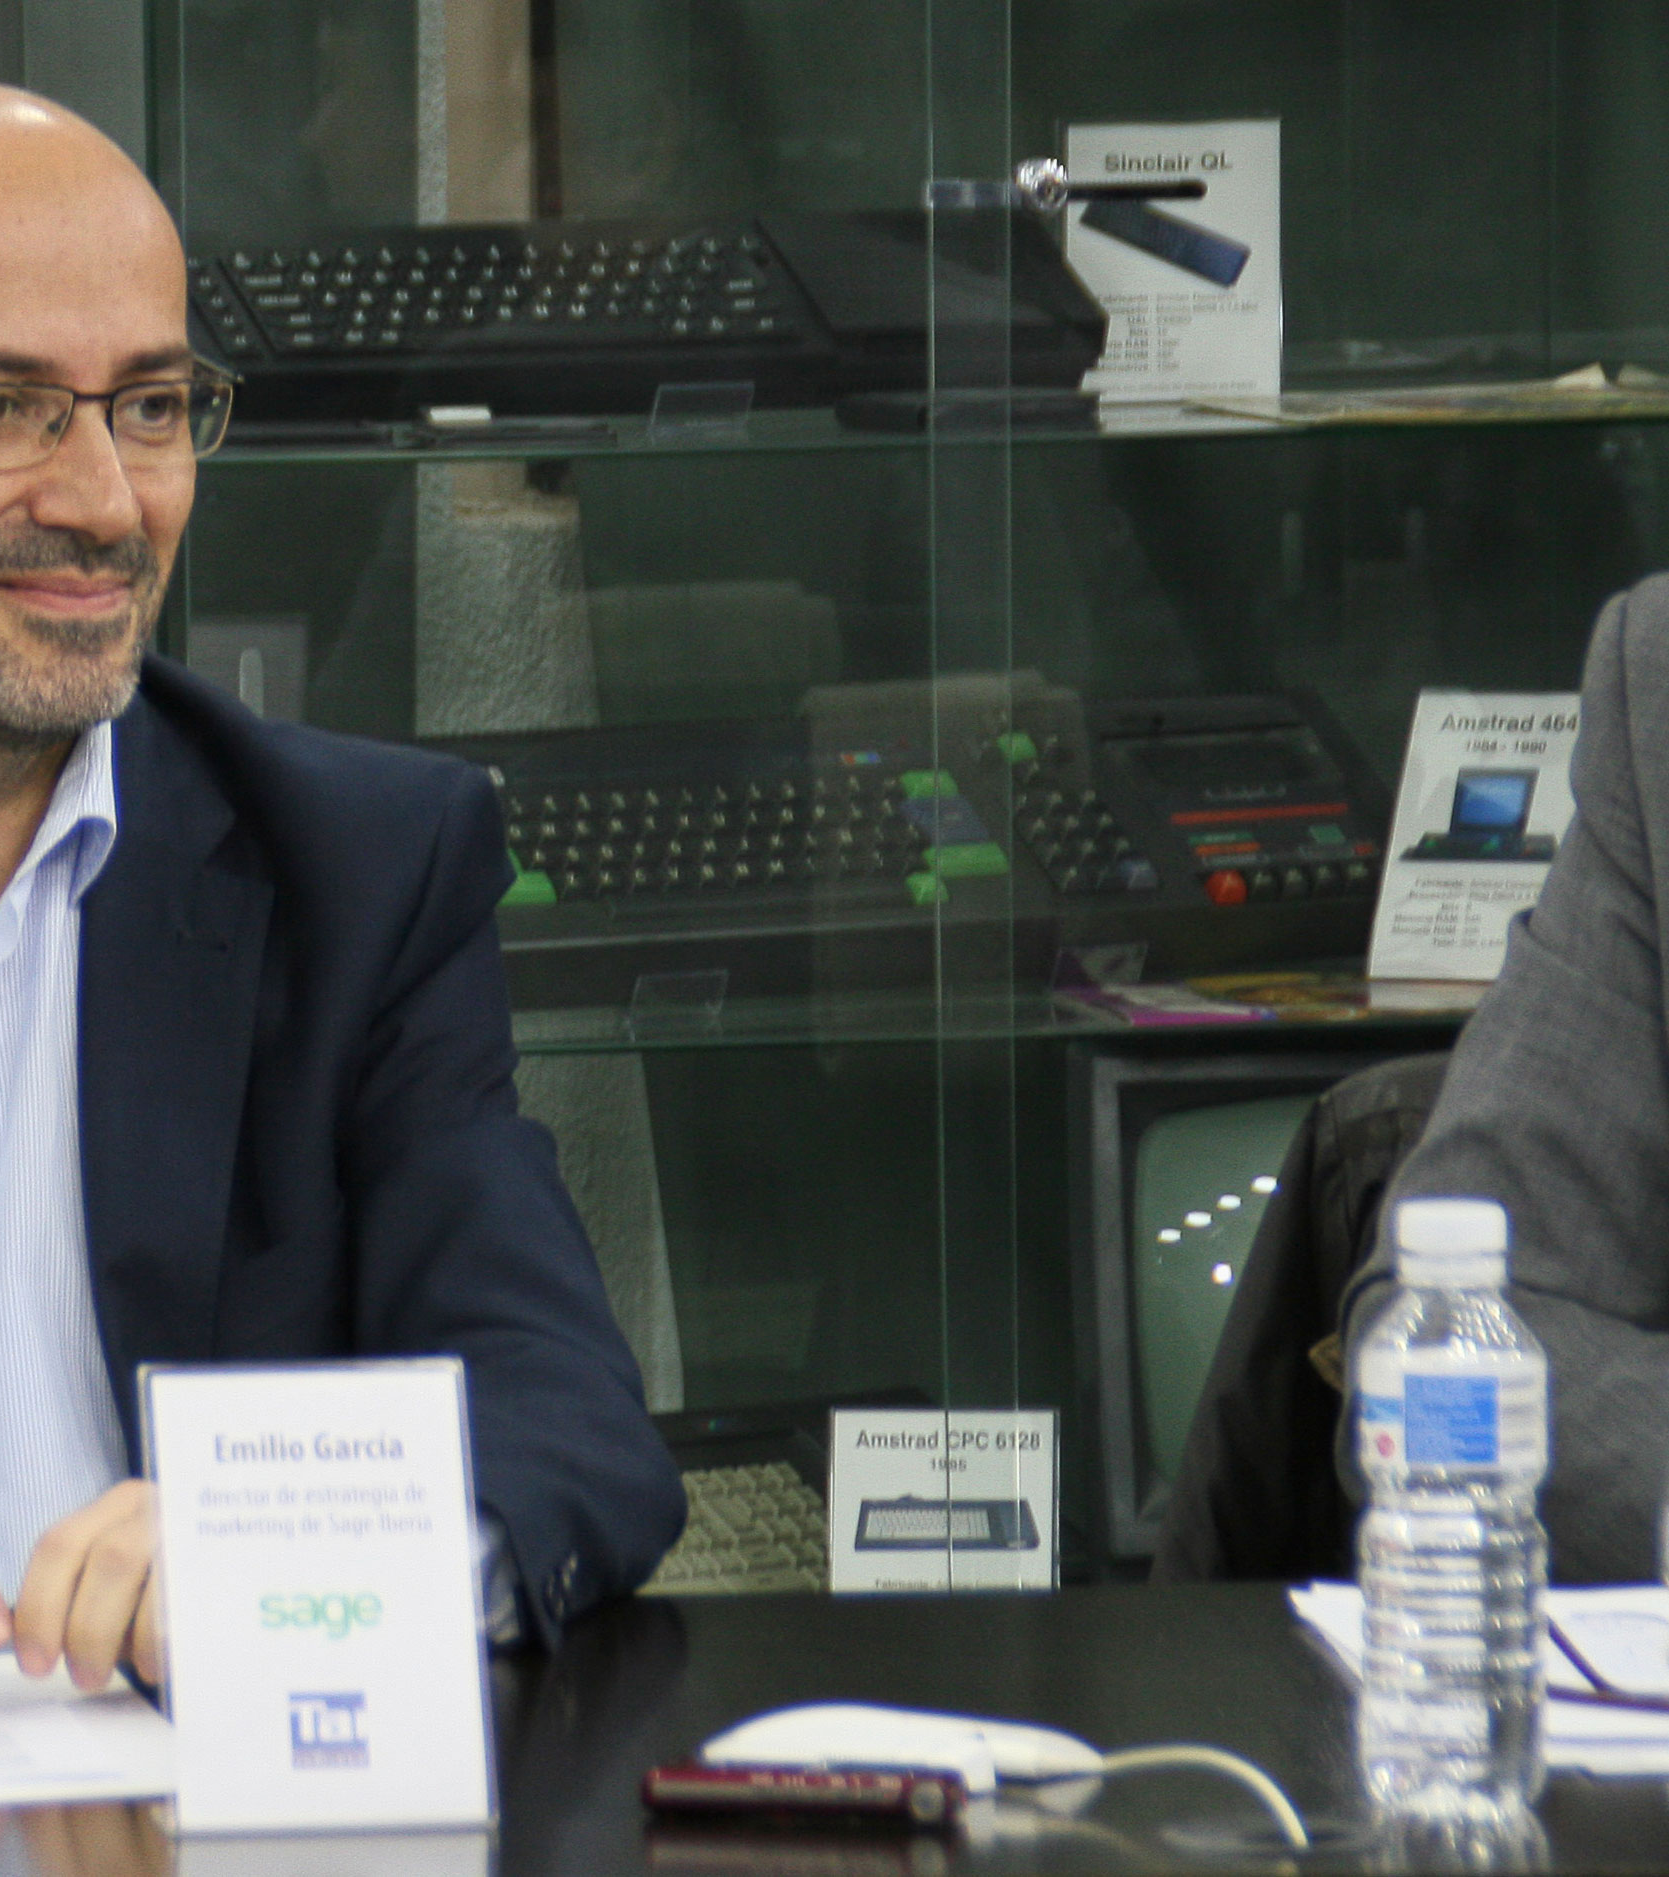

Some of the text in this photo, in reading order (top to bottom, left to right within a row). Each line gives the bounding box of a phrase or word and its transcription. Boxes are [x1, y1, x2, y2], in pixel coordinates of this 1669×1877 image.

[1105, 152, 1232, 171] Sinclair QL
[1441, 713, 1578, 733] Amstrad 464
[214, 1430, 404, 1463] Emilio García
[855, 1429, 1041, 1450] Amstrad CPC 6128
[259, 1592, 383, 1641] sage
